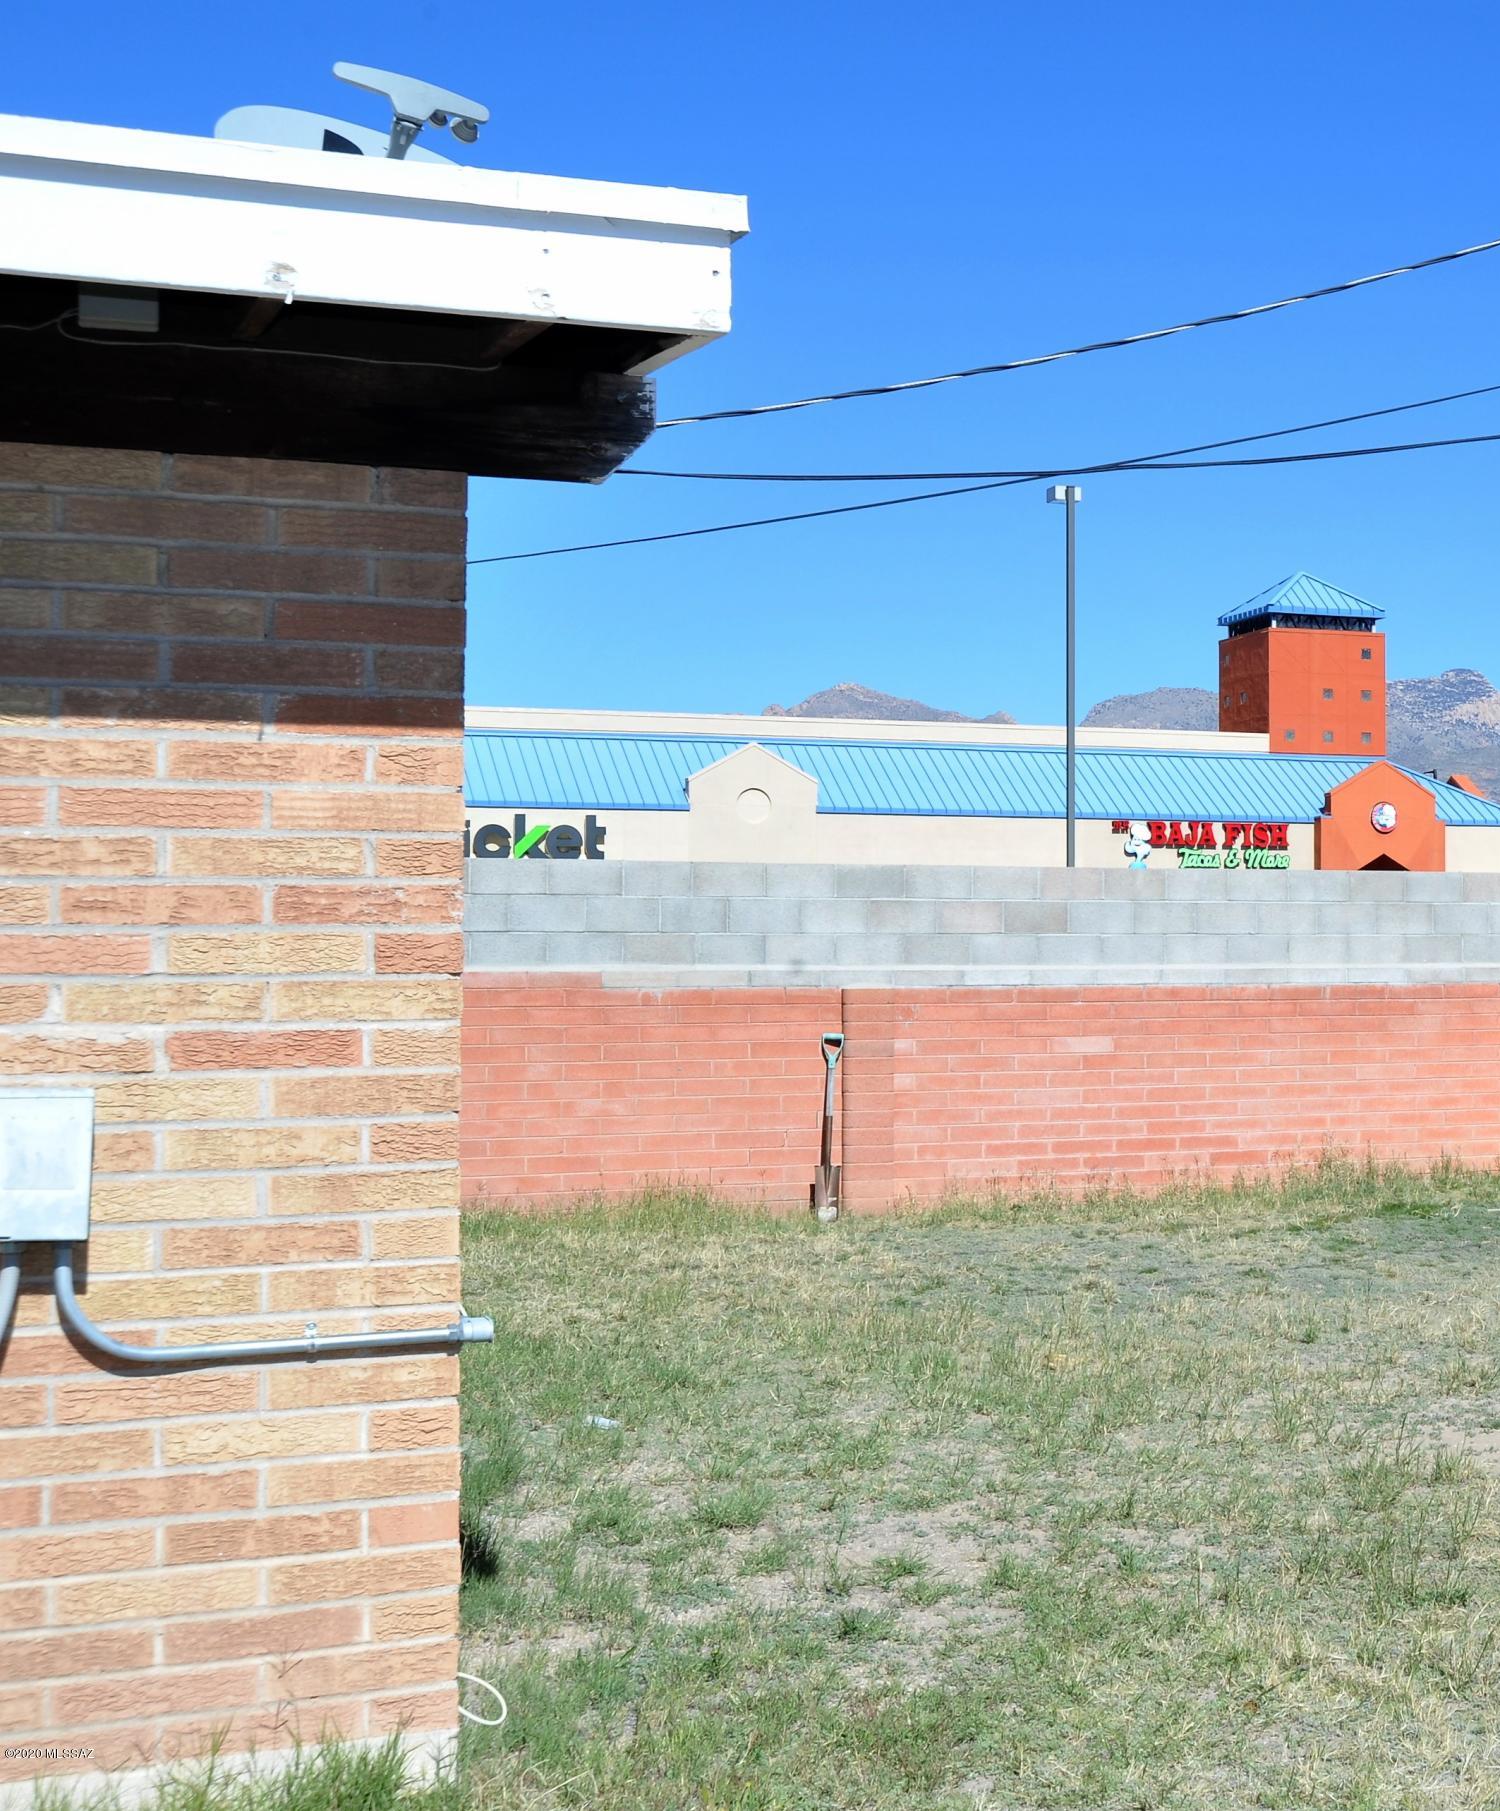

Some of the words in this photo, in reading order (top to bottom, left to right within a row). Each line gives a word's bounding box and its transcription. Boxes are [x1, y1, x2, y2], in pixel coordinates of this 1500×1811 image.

[1147, 821, 1217, 848] BAJA
[1222, 822, 1290, 849] FISH
[1178, 847, 1221, 869] Tacos
[1224, 848, 1240, 869] &
[1244, 848, 1291, 869] More
